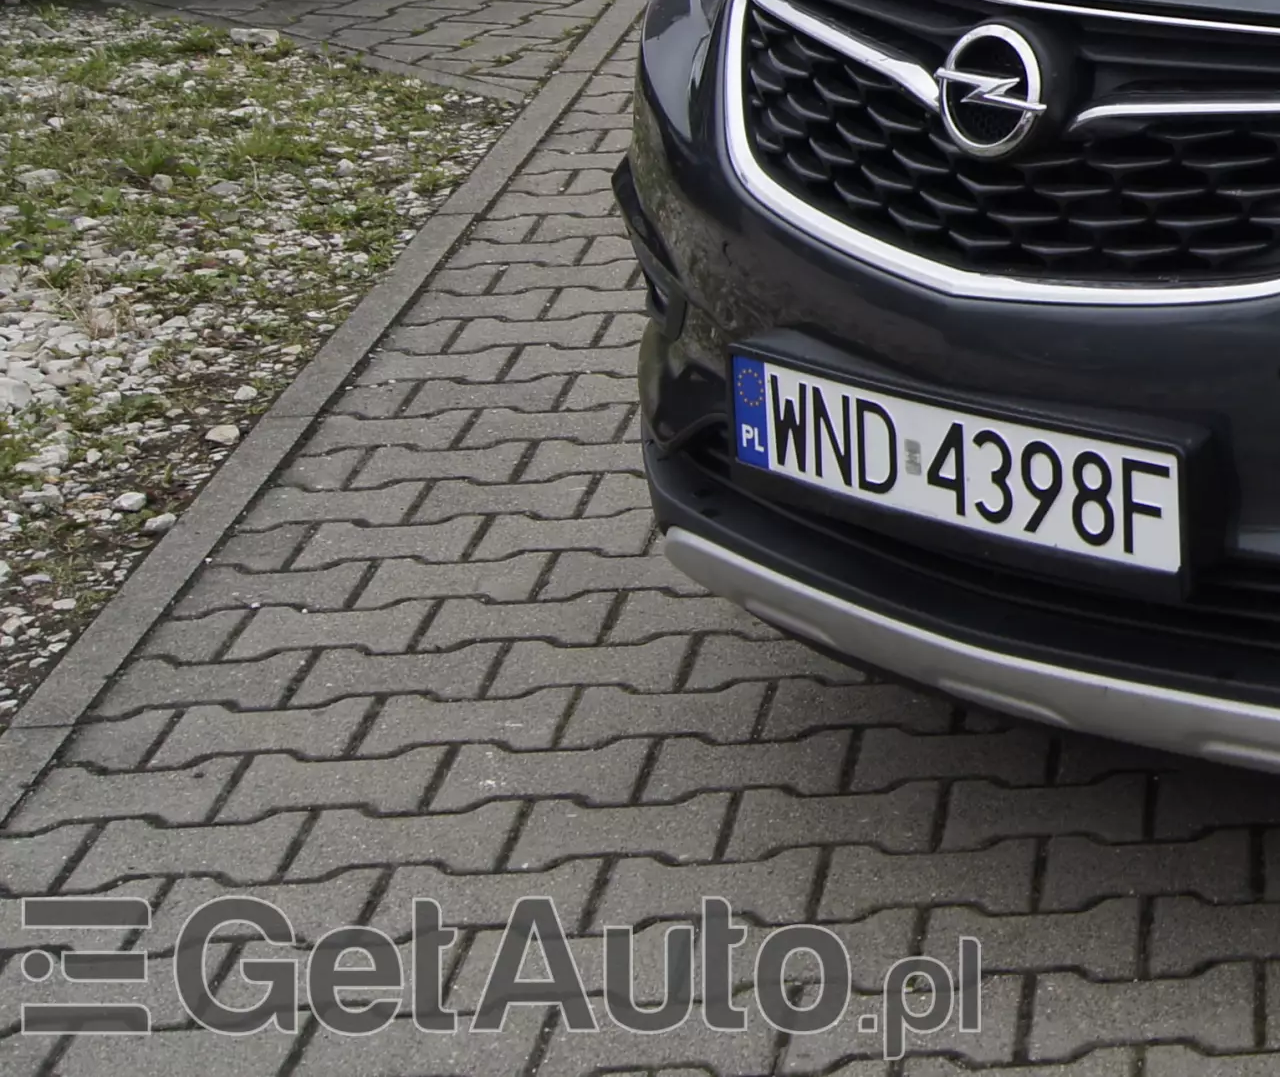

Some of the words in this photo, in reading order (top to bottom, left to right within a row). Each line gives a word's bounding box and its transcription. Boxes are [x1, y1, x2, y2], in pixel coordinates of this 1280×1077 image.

[742, 423, 765, 453] PL
[770, 374, 898, 494] WND
[926, 421, 1171, 554] 4398F
